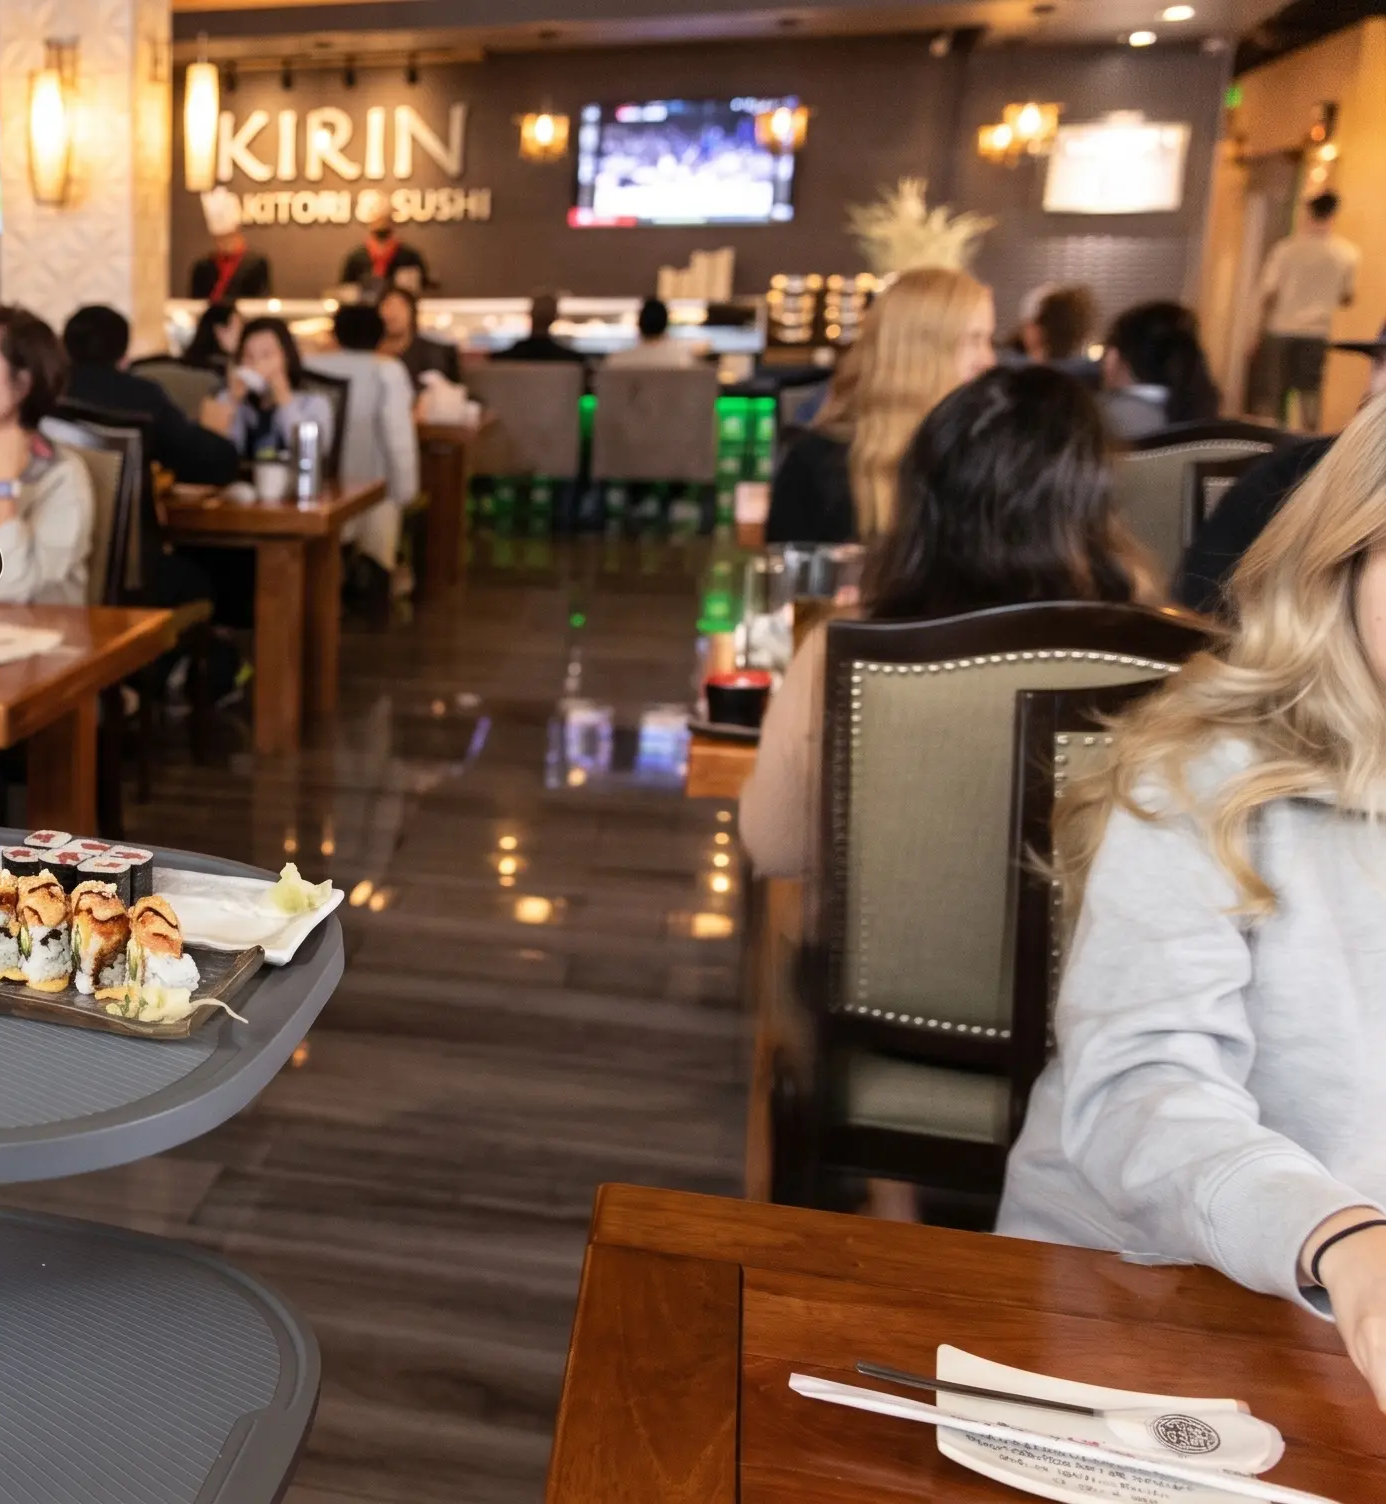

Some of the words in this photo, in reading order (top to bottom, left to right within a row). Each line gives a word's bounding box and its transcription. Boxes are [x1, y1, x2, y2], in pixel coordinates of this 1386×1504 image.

[217, 104, 466, 182] KIRIN
[240, 189, 352, 224] KITORI
[390, 188, 492, 222] SUSHI
